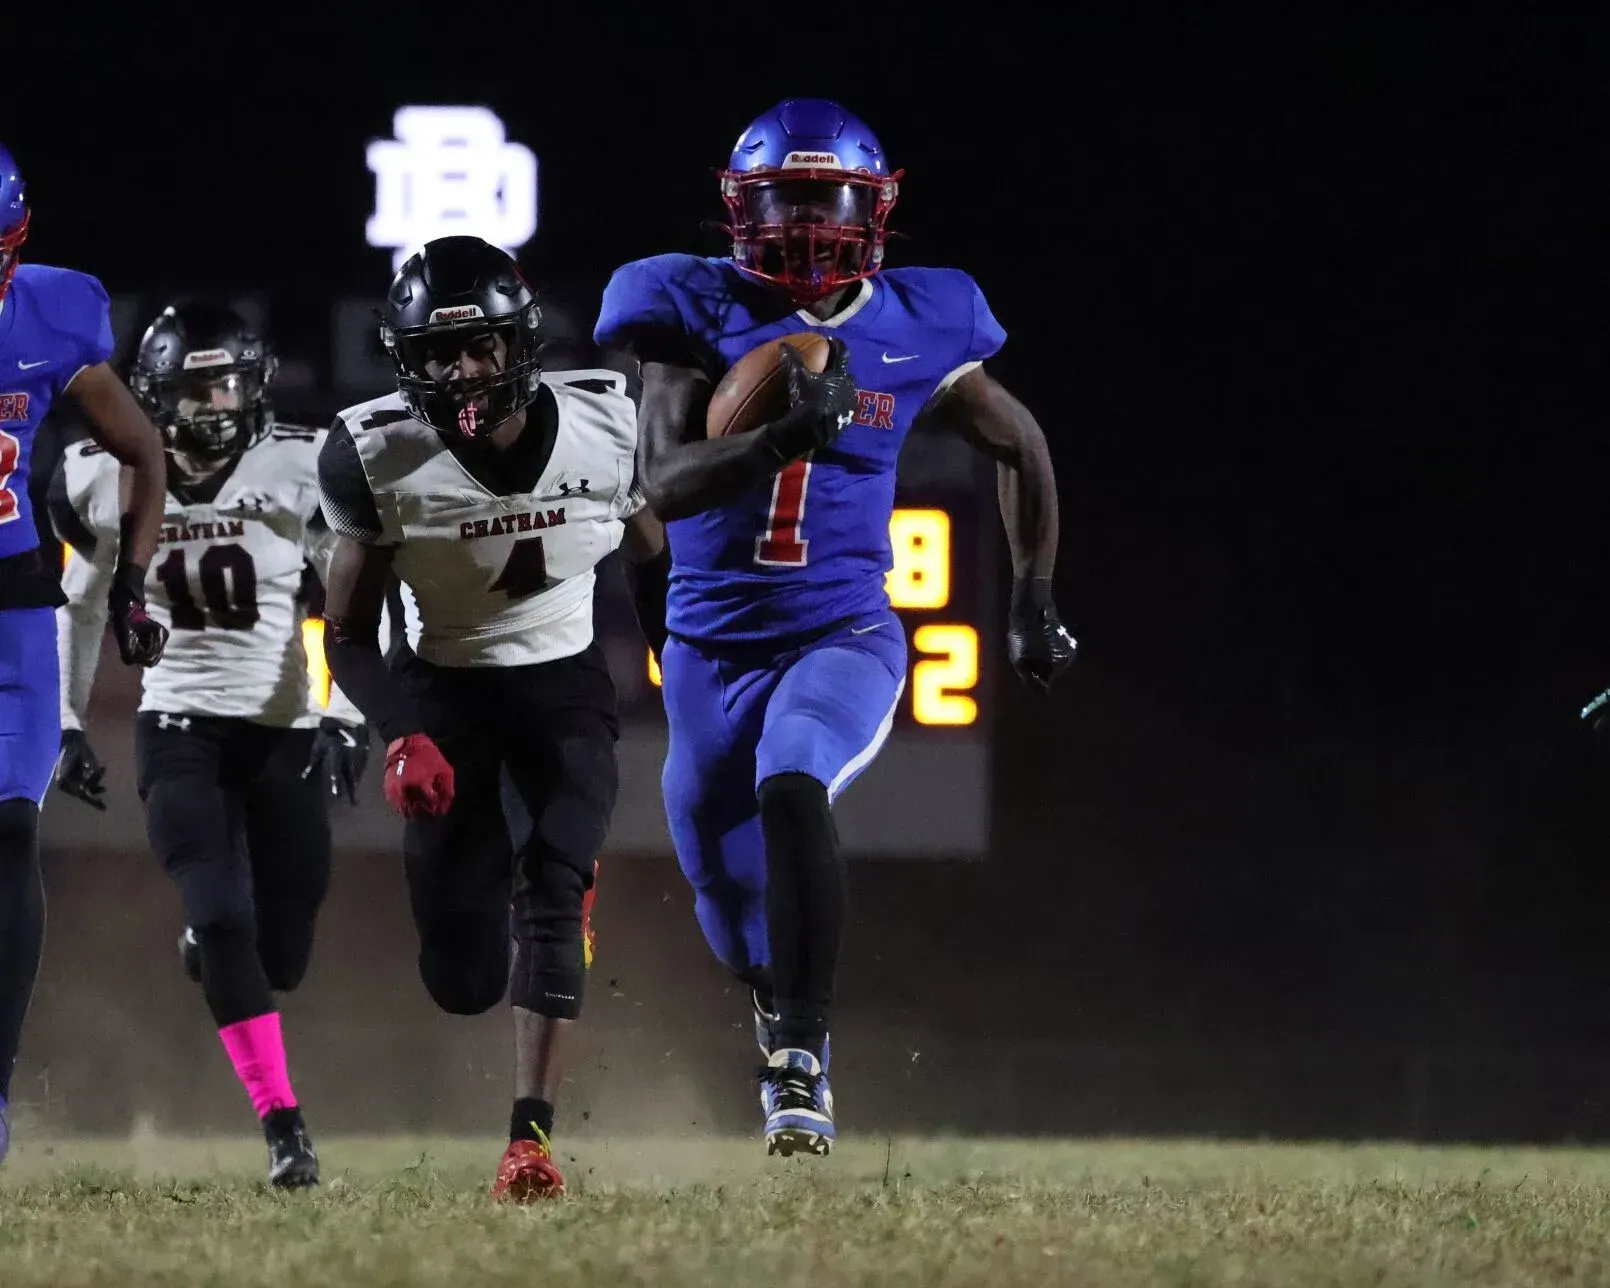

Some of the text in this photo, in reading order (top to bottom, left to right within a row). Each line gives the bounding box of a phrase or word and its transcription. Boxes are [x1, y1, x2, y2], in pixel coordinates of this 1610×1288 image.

[460, 507, 567, 540] CHATHAM
[753, 456, 812, 567] 1
[884, 508, 951, 609] 8
[156, 543, 261, 631] 10
[487, 536, 547, 600] 4
[912, 623, 979, 725] 2
